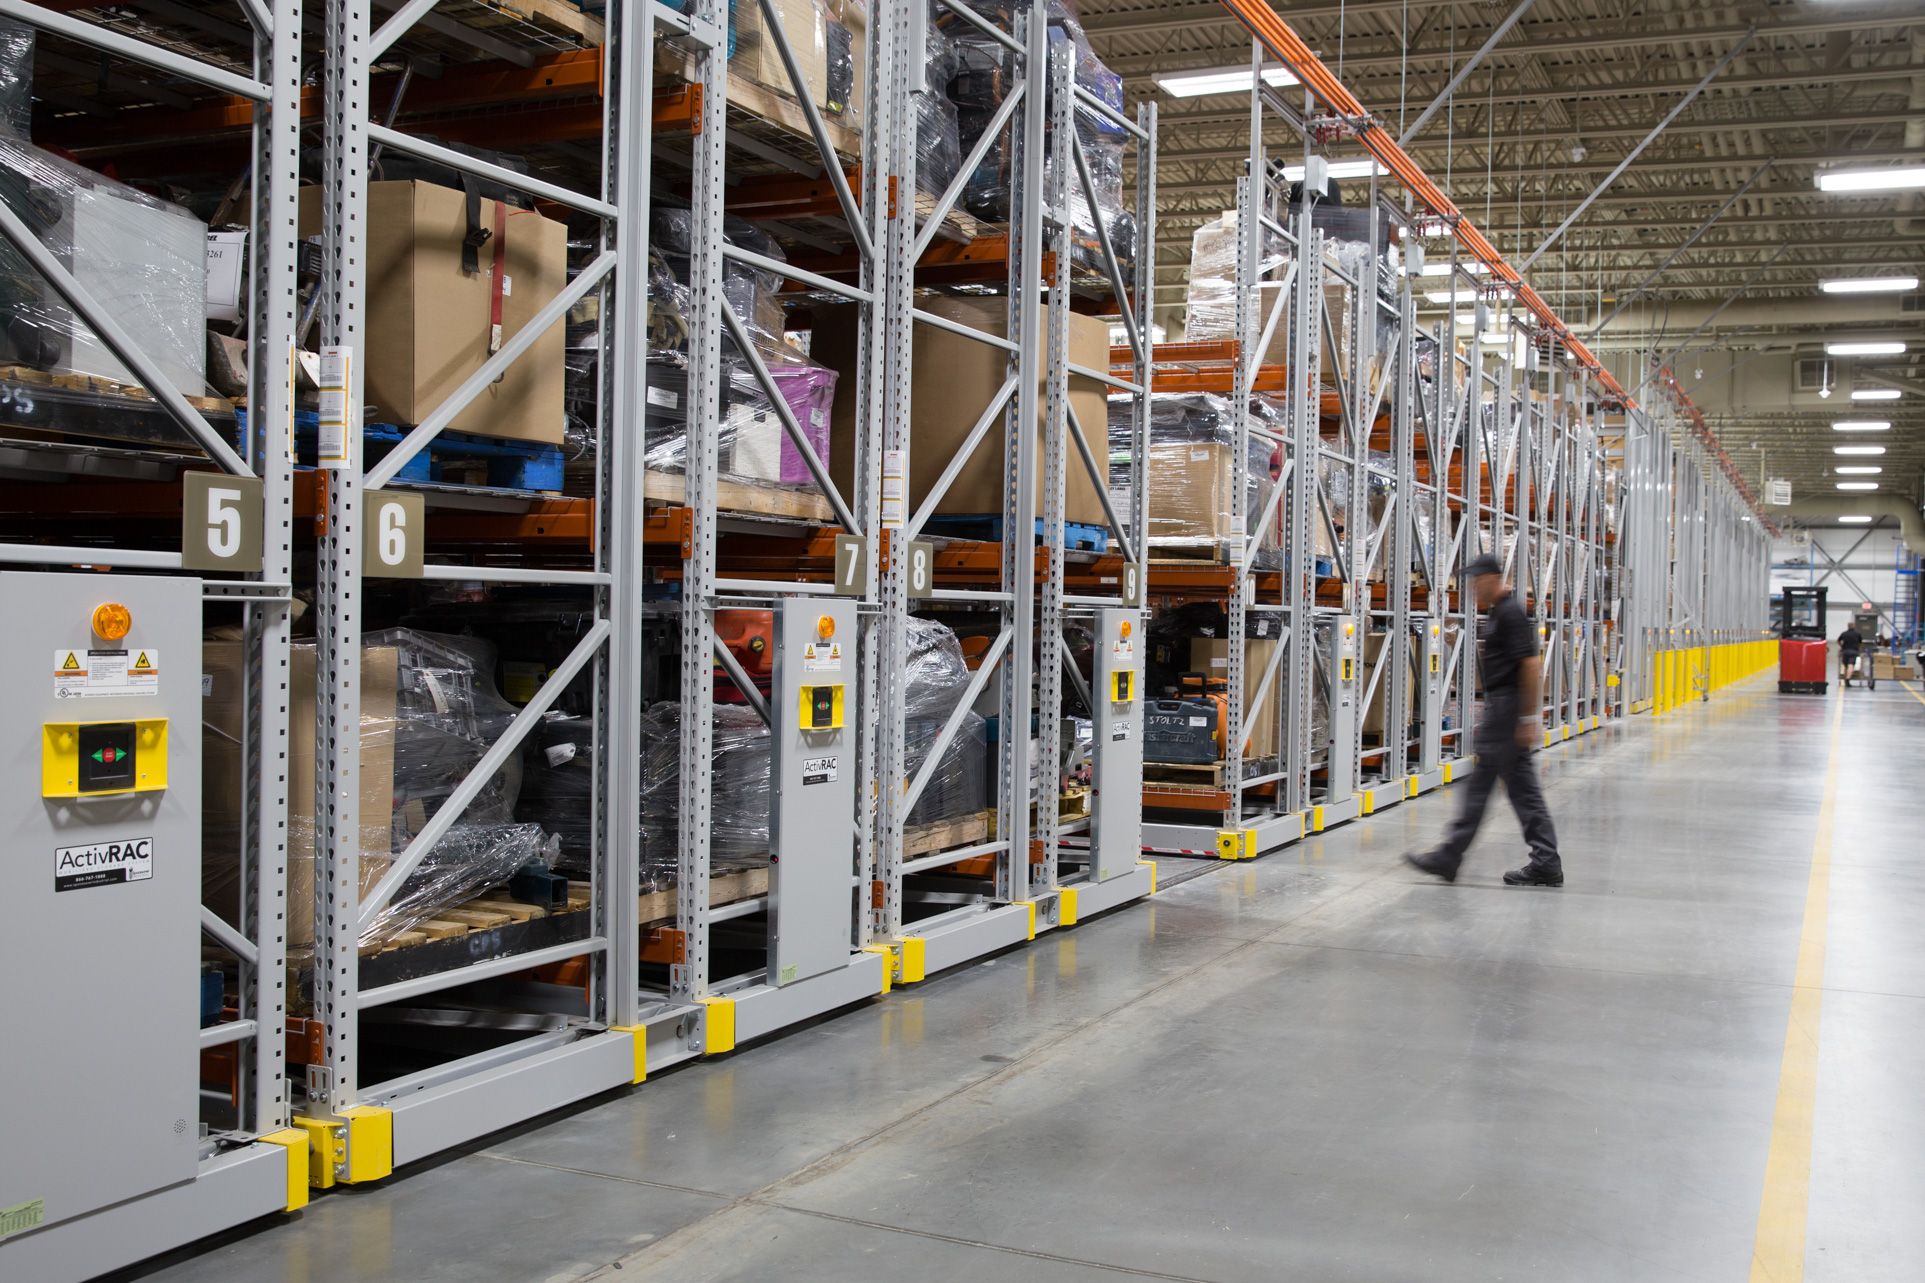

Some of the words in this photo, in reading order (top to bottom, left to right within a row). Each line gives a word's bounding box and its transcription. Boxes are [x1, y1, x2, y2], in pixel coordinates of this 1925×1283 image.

[207, 487, 241, 558] 5
[379, 502, 406, 566] 6
[845, 543, 859, 586] 7
[913, 549, 926, 591] 8
[1128, 568, 1136, 601] 9
[1245, 579, 1255, 606] 10
[804, 758, 837, 773] ActivRAC
[59, 841, 150, 870] ActivRAC
